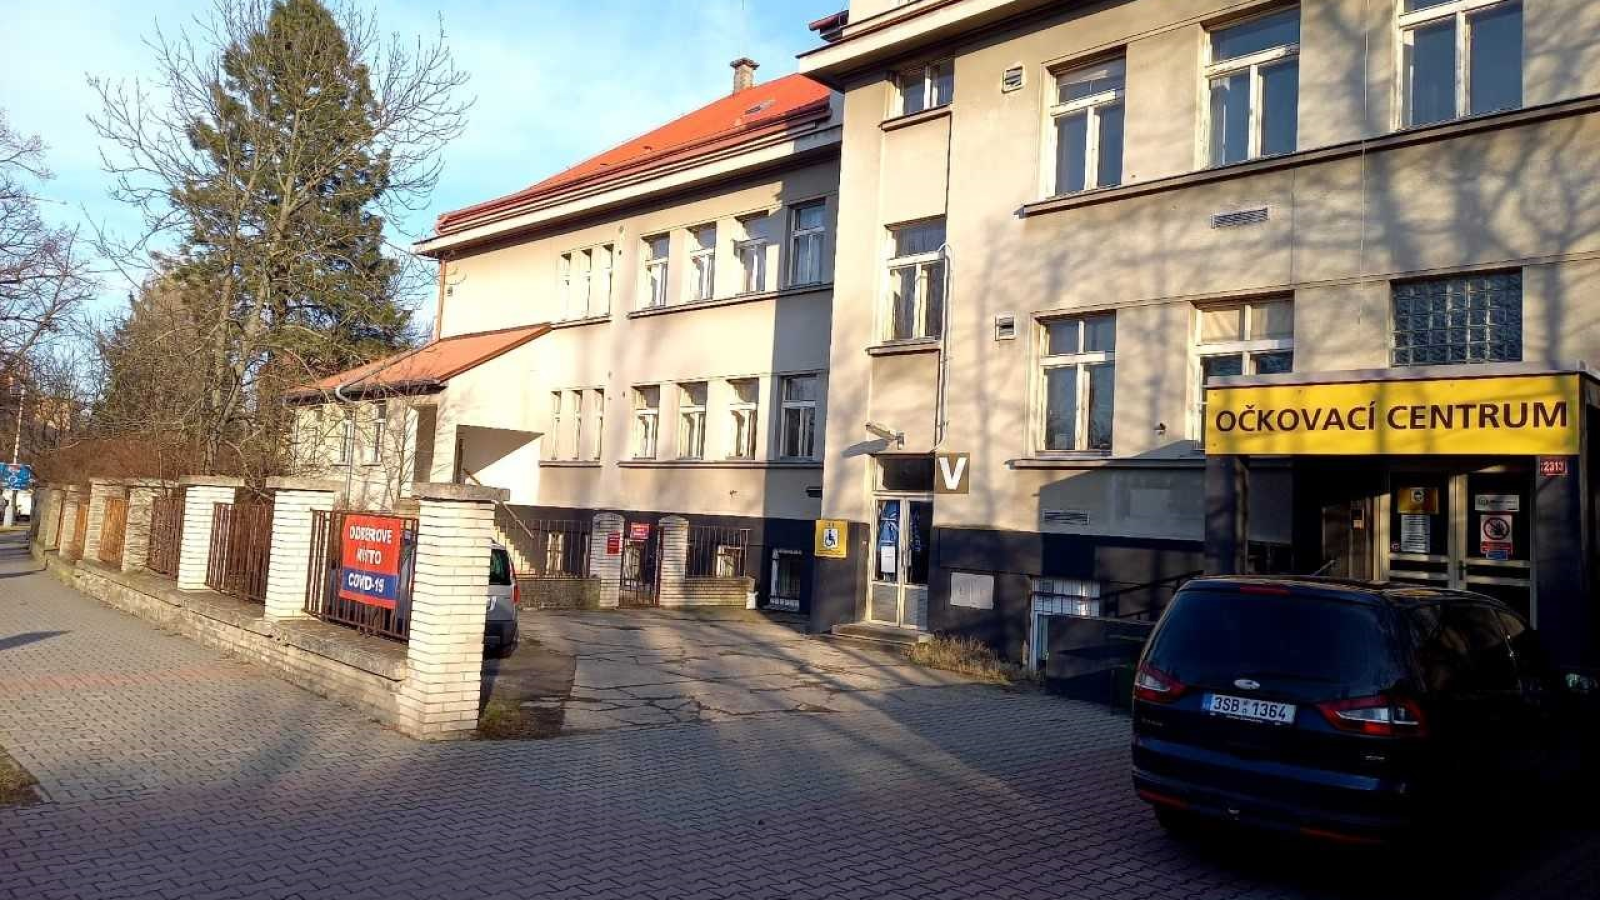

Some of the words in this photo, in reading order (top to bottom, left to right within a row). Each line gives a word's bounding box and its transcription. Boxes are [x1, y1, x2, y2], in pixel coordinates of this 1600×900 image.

[1215, 400, 1375, 431] OČKOVACÍ
[1387, 401, 1567, 430] CENTRUM
[939, 457, 967, 490] V
[1213, 696, 1240, 712] 3SB
[1252, 703, 1287, 720] 1364
